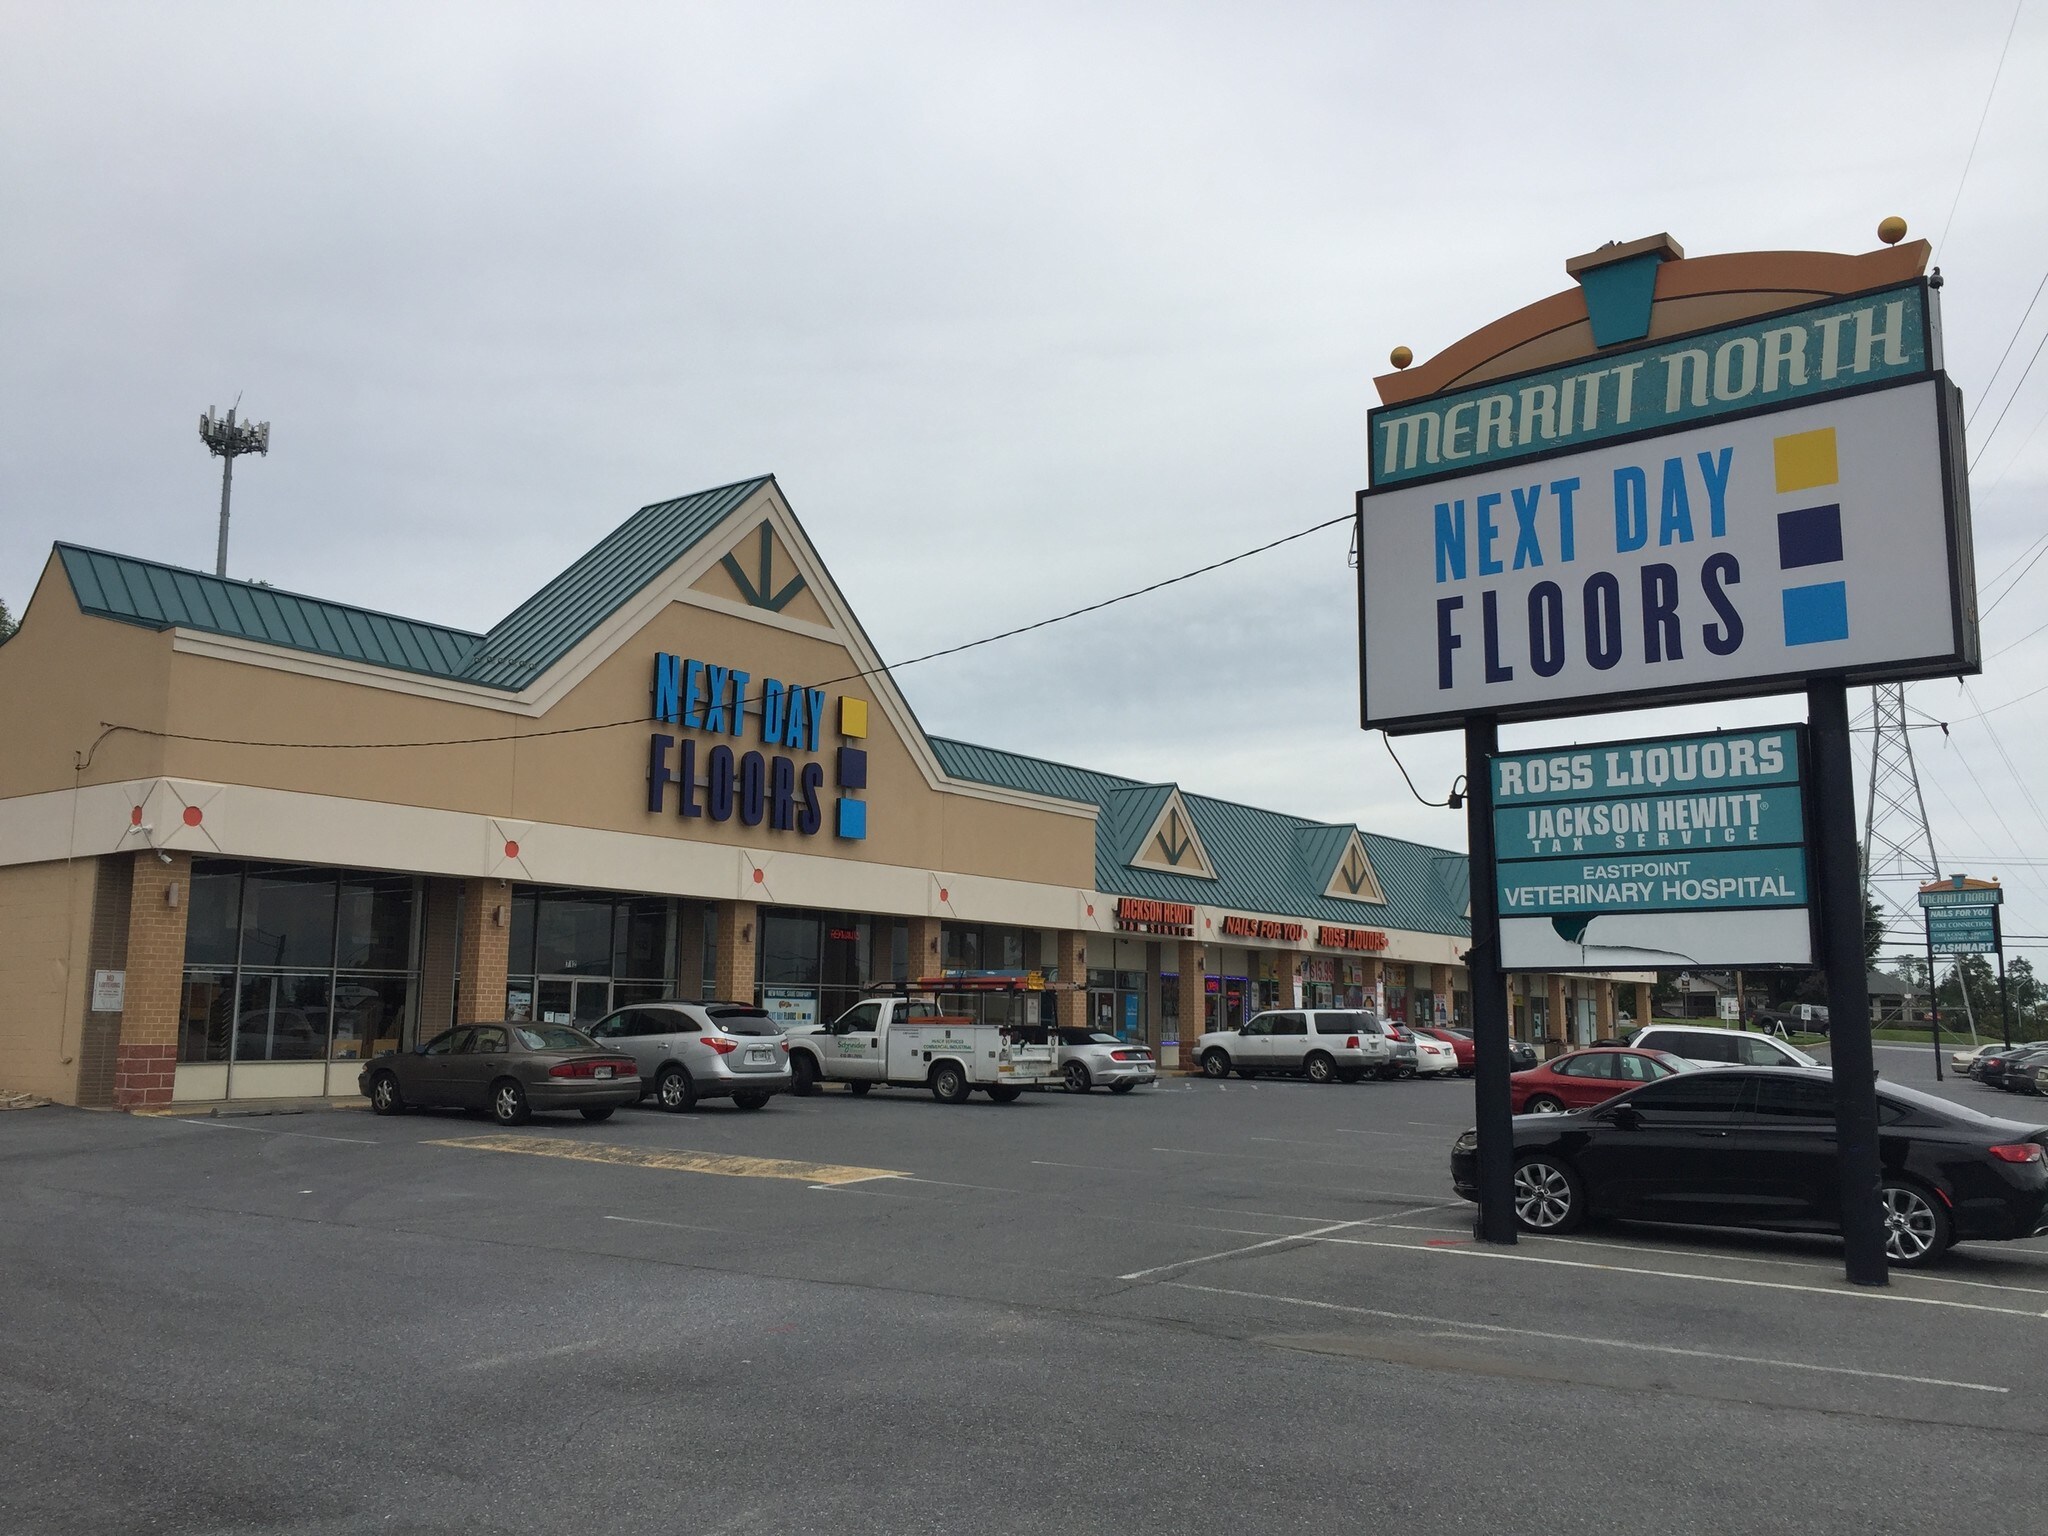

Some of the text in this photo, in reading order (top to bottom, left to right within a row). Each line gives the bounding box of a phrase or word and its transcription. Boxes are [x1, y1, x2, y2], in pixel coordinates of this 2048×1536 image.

[1380, 300, 1909, 475] MERRITT NORTH
[1434, 446, 1733, 583] NEXT DAY
[1437, 551, 1744, 689] FLOORS
[654, 651, 826, 752] NEXT DAY
[1499, 736, 1784, 796] ROSS LIQUORS
[648, 733, 823, 835] FLOORS
[1527, 802, 1649, 840] JACKSON
[1531, 827, 1759, 853] TAX SERVICE
[1583, 861, 1691, 880] EASTPOINT
[1504, 876, 1795, 907] VETERINARY HOSPITAL
[1921, 891, 1998, 904] MERRITT NORTH
[1120, 898, 1196, 925] JACKSON HEWITT
[1955, 909, 1971, 917] FOR
[1226, 916, 1303, 941] NAILS FOR YOU
[1321, 927, 1386, 950] ROSS LIQUORS
[1932, 943, 1994, 953] CASHMART
